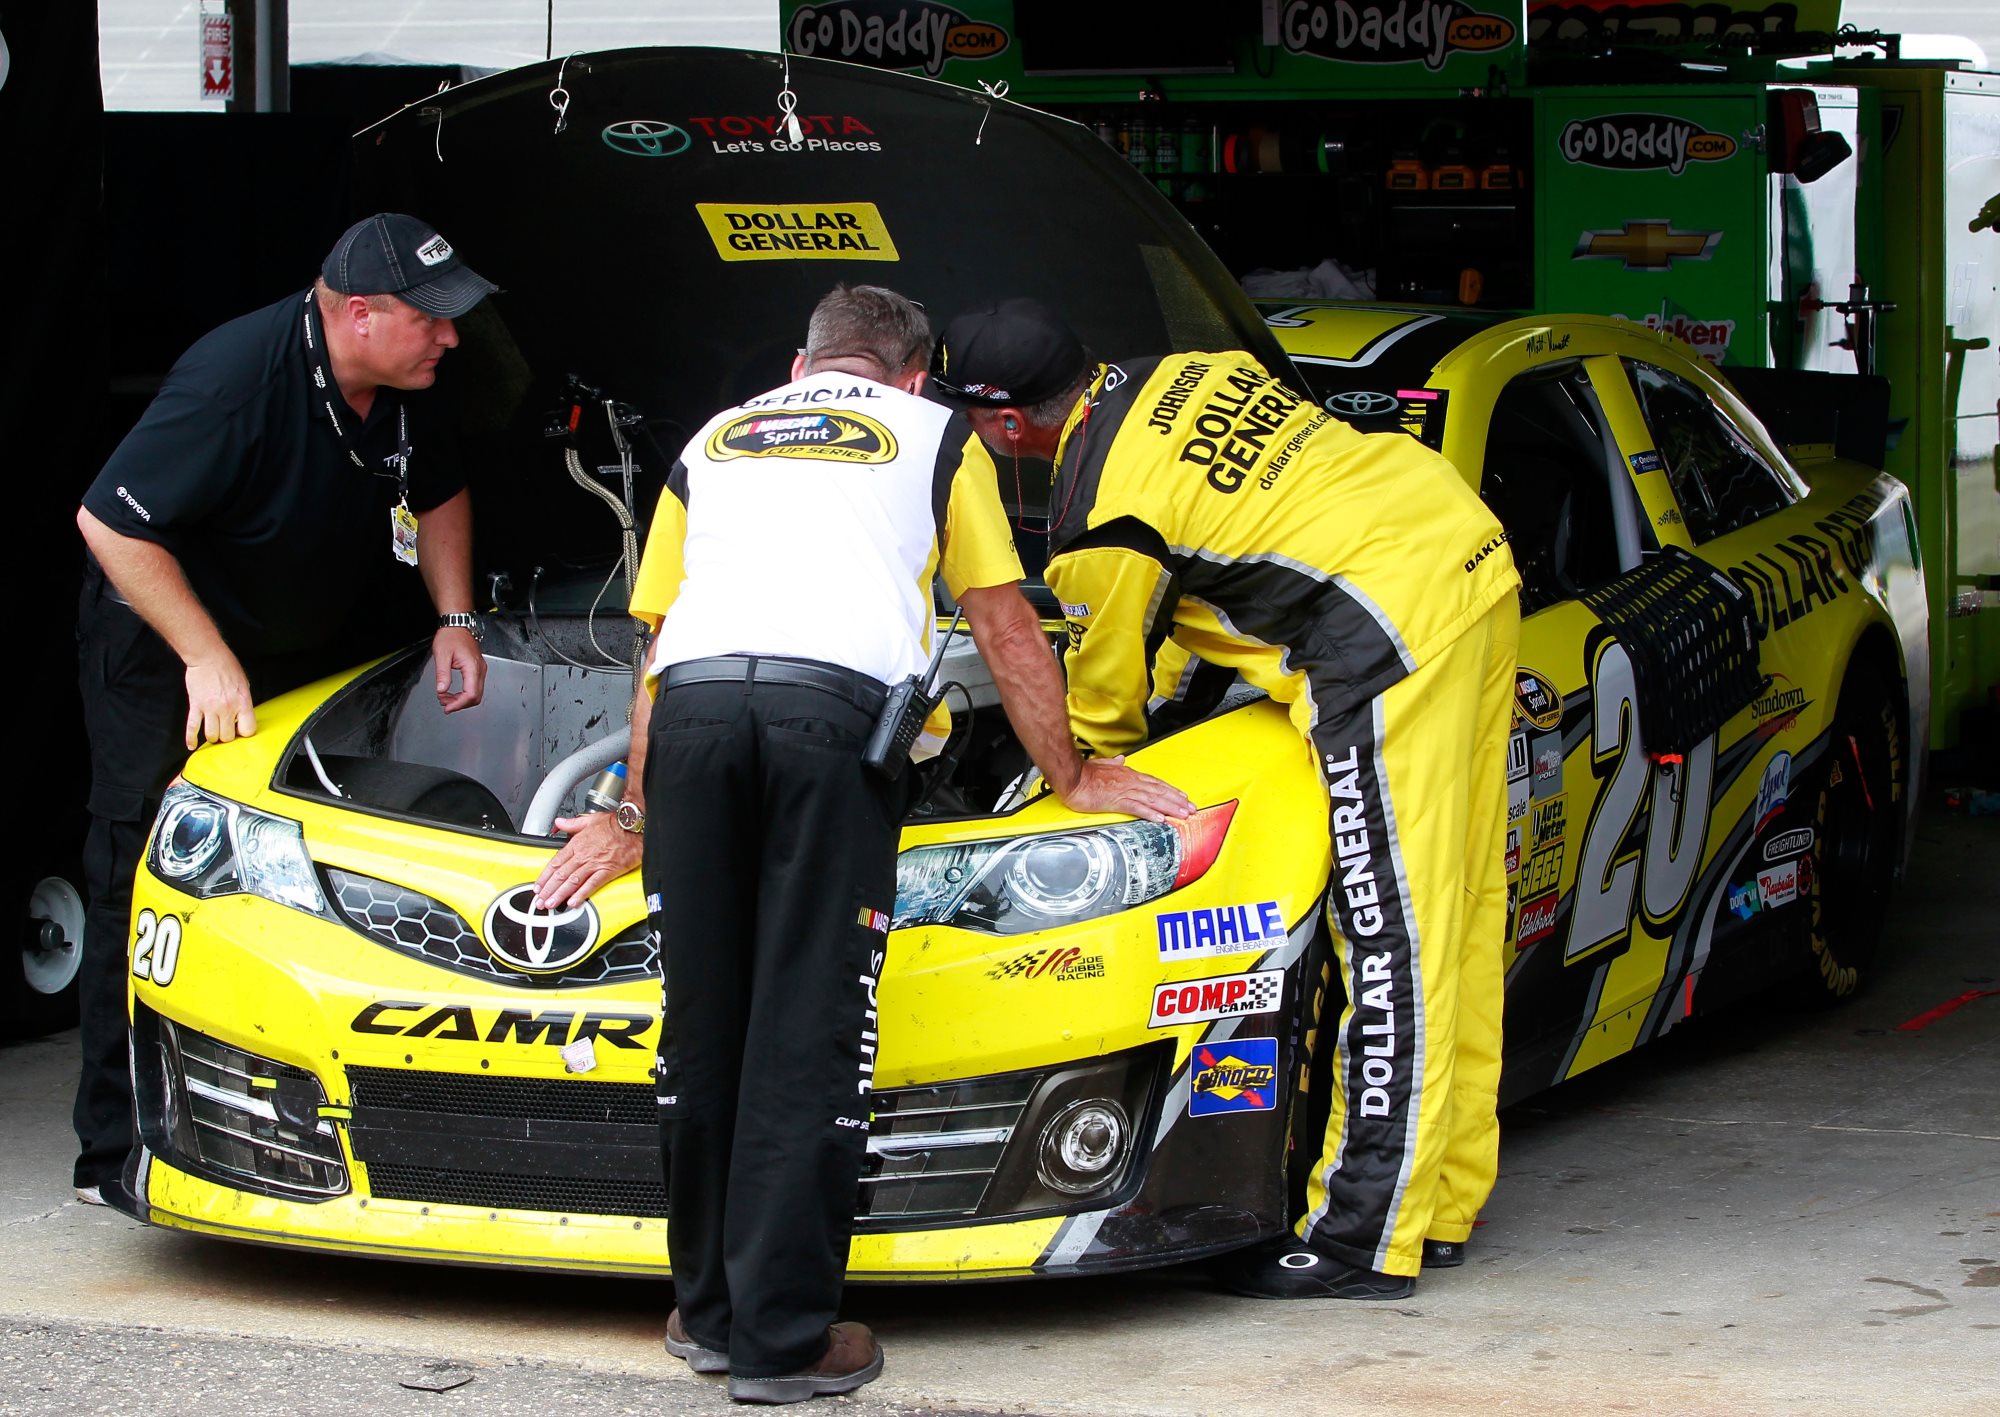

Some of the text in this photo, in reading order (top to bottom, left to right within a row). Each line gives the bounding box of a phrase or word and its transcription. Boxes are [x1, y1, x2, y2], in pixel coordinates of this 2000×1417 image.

[206, 27, 228, 42] FIRE
[711, 138, 882, 154] Let's Go Places
[724, 212, 862, 231] DOLLAR
[727, 232, 881, 252] GENERAL
[738, 386, 882, 409] OFFICIAL
[1148, 360, 1215, 436] JOHNSON
[755, 415, 826, 433] NASCAR
[1178, 367, 1271, 466] DOLLAR
[762, 427, 830, 445] Sprint
[1206, 381, 1302, 494] GENERA
[767, 446, 872, 461] CUP SERIES
[125, 493, 151, 522] TOYOTA
[1464, 532, 1508, 574] OAKLE
[1727, 534, 1849, 642] OLLAR
[1528, 692, 1547, 712] Sprint
[1751, 687, 1806, 720] Sundown
[1538, 768, 1558, 782] POLE
[1541, 800, 1564, 825] Auto
[1566, 636, 1716, 965] 20
[1540, 818, 1566, 844] Meter
[1767, 832, 1810, 857] FREIGHTLINER
[1521, 844, 1563, 901] JEGS
[1157, 901, 1286, 952] MAHLE
[1327, 746, 1396, 1117] DOLLAR GENERAL
[134, 908, 182, 986] 20
[1215, 937, 1287, 954] ENGINE BEARINGS
[1065, 963, 1105, 973] GIBBS
[1077, 955, 1103, 964] JOE
[1056, 970, 1105, 982] RACING
[1156, 980, 1248, 1017] COMP
[1218, 999, 1268, 1014] CAMS
[350, 1000, 656, 1050] CAMR
[1198, 1067, 1273, 1091] SUNOCO
[835, 1116, 861, 1128] CUP
